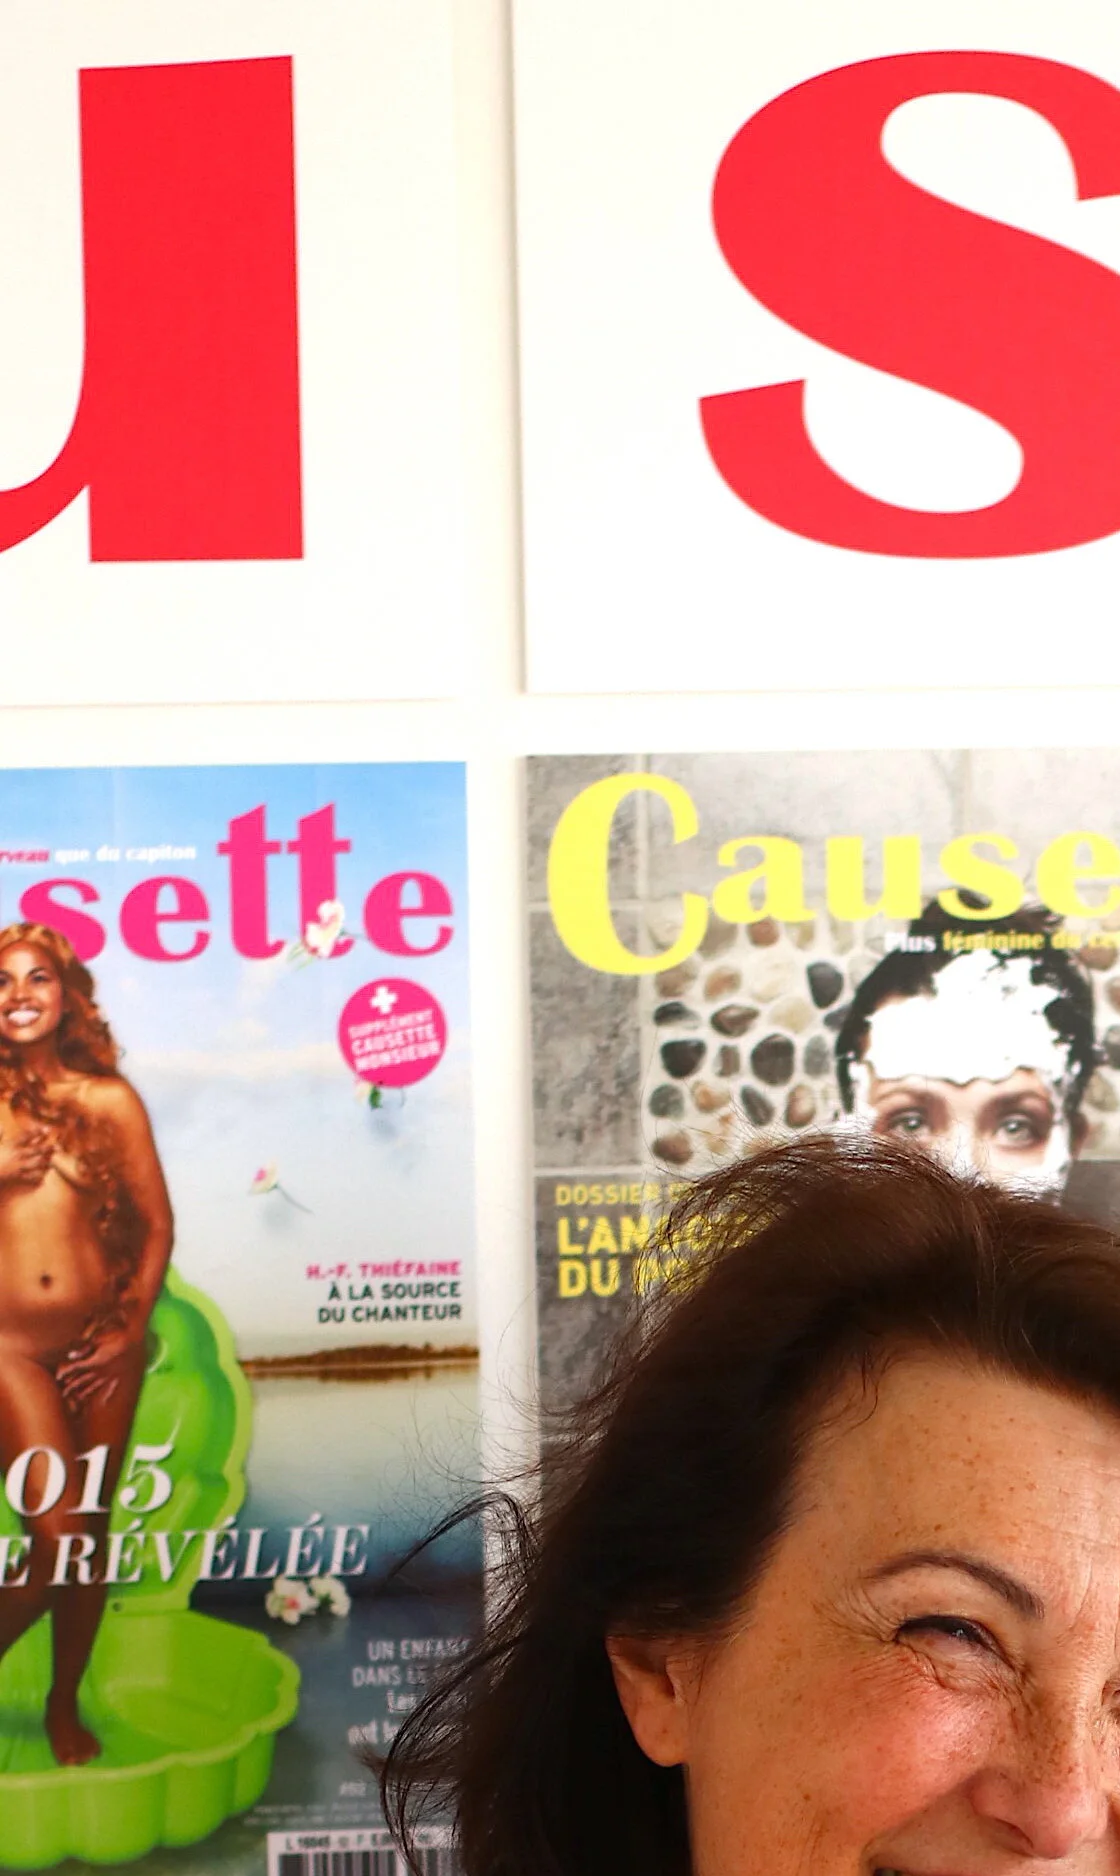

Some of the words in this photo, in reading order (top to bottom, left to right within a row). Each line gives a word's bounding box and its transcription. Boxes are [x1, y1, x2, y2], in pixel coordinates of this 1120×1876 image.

[96, 845, 120, 862] du
[126, 845, 197, 866] capiton
[883, 930, 937, 953] Plus
[942, 929, 1044, 951] féminine
[1052, 929, 1083, 950] du
[352, 1023, 437, 1057] CAUSETTE
[355, 1040, 441, 1073] MONSIEUR
[555, 1184, 660, 1206] DOSSIER
[559, 1259, 621, 1298] DU
[348, 1284, 373, 1301] LA
[381, 1282, 461, 1299] SOURCE
[318, 1307, 345, 1323] DU
[352, 1304, 462, 1322] CHANTEUR
[48, 1512, 370, 1586] RÉVÉLÉE
[367, 1640, 395, 1661] UN
[352, 1665, 401, 1688] DANS
